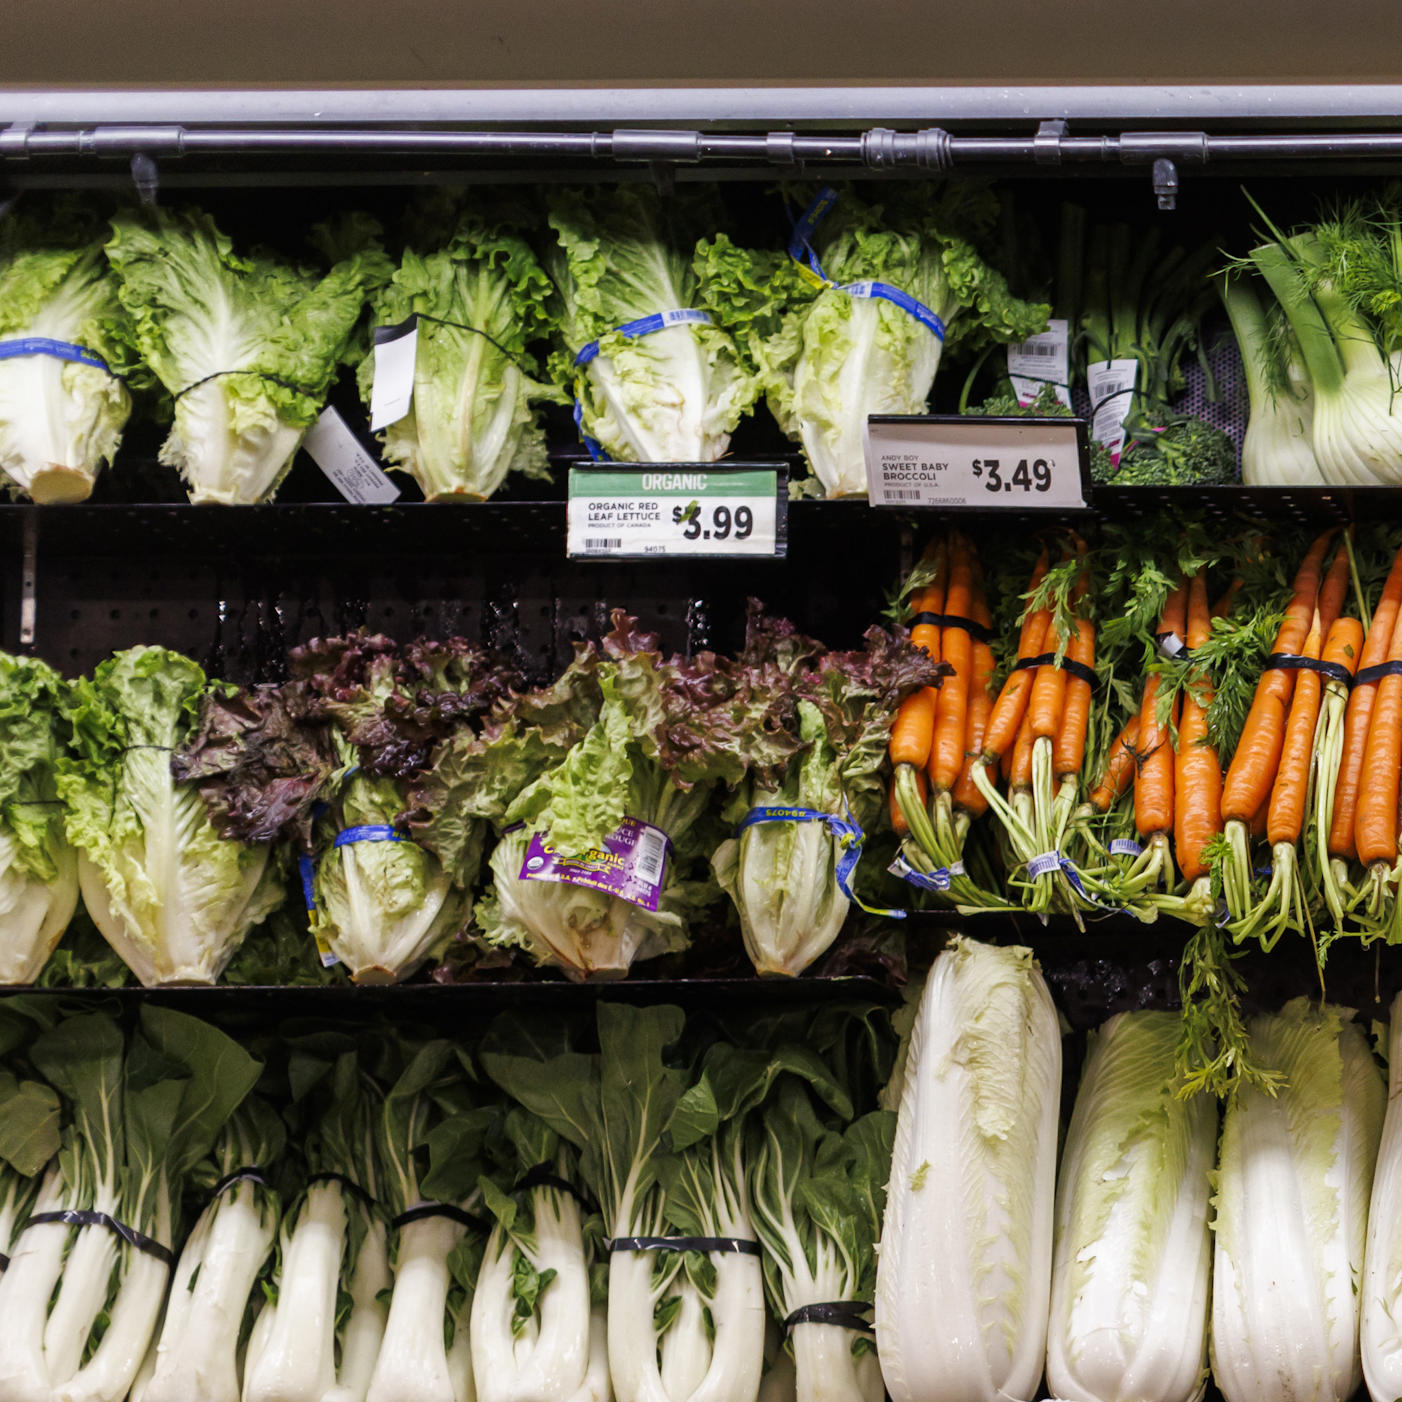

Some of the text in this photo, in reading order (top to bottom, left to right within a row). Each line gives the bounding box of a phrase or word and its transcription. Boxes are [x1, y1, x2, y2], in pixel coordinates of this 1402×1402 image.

[882, 463, 949, 471] SWEET BABY
[883, 472, 936, 481] BROCCOLI
[972, 458, 1052, 492] $3.49
[641, 474, 708, 490] ORGANIC
[588, 502, 658, 511] ORGANIC RED
[588, 512, 661, 521] LEAF LETTUCE
